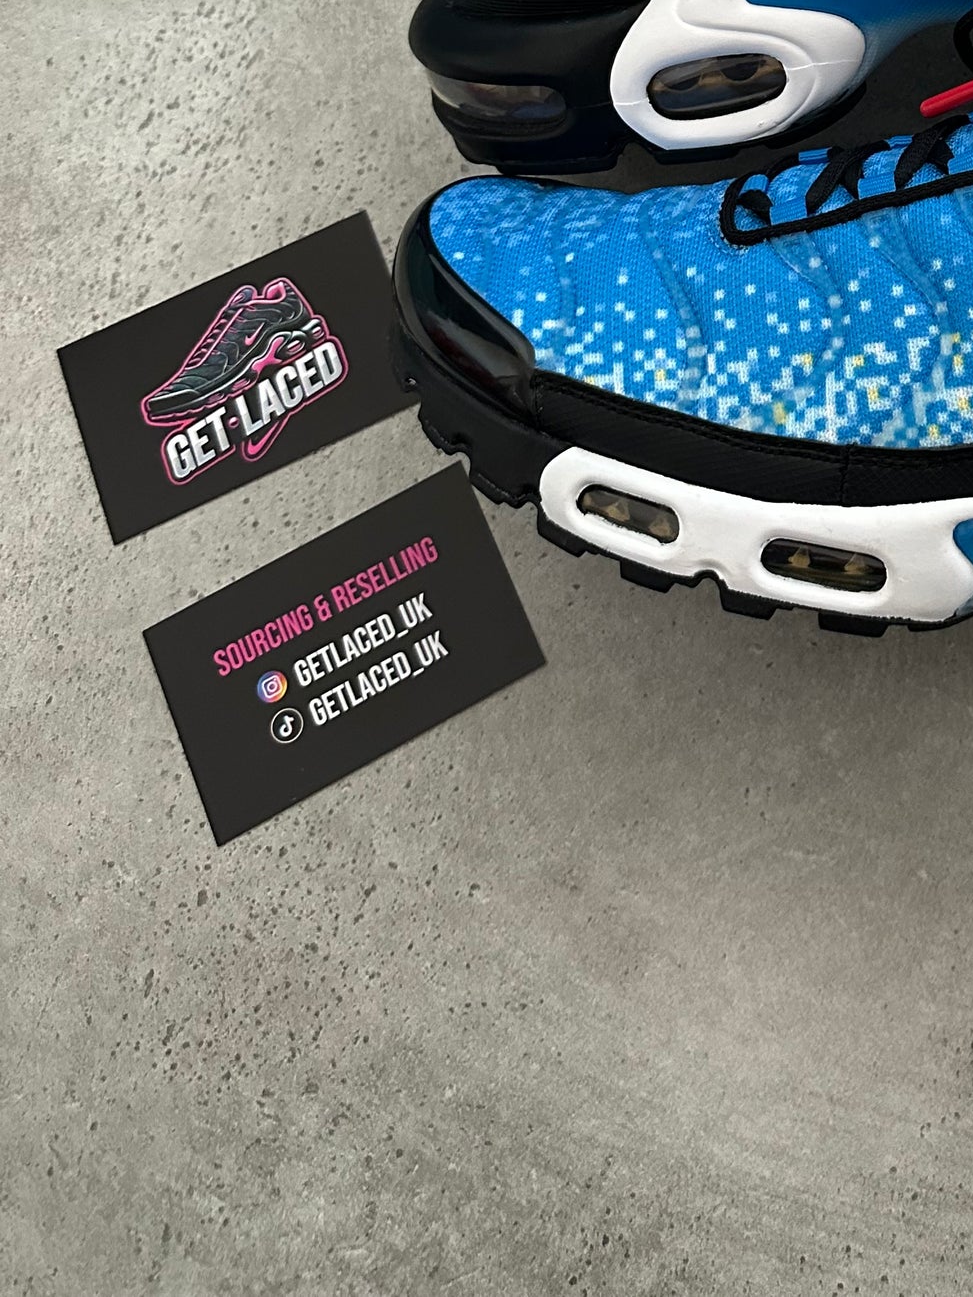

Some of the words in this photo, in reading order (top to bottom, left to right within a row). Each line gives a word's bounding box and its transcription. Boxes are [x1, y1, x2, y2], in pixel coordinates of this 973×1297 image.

[166, 406, 231, 479] GET
[235, 341, 343, 436] LACED
[212, 604, 314, 677] SOURCING
[313, 594, 333, 622] &
[331, 536, 438, 613] RESELLING
[293, 592, 433, 687] GETLACED_UK
[308, 630, 449, 726] GETLACED_UK
